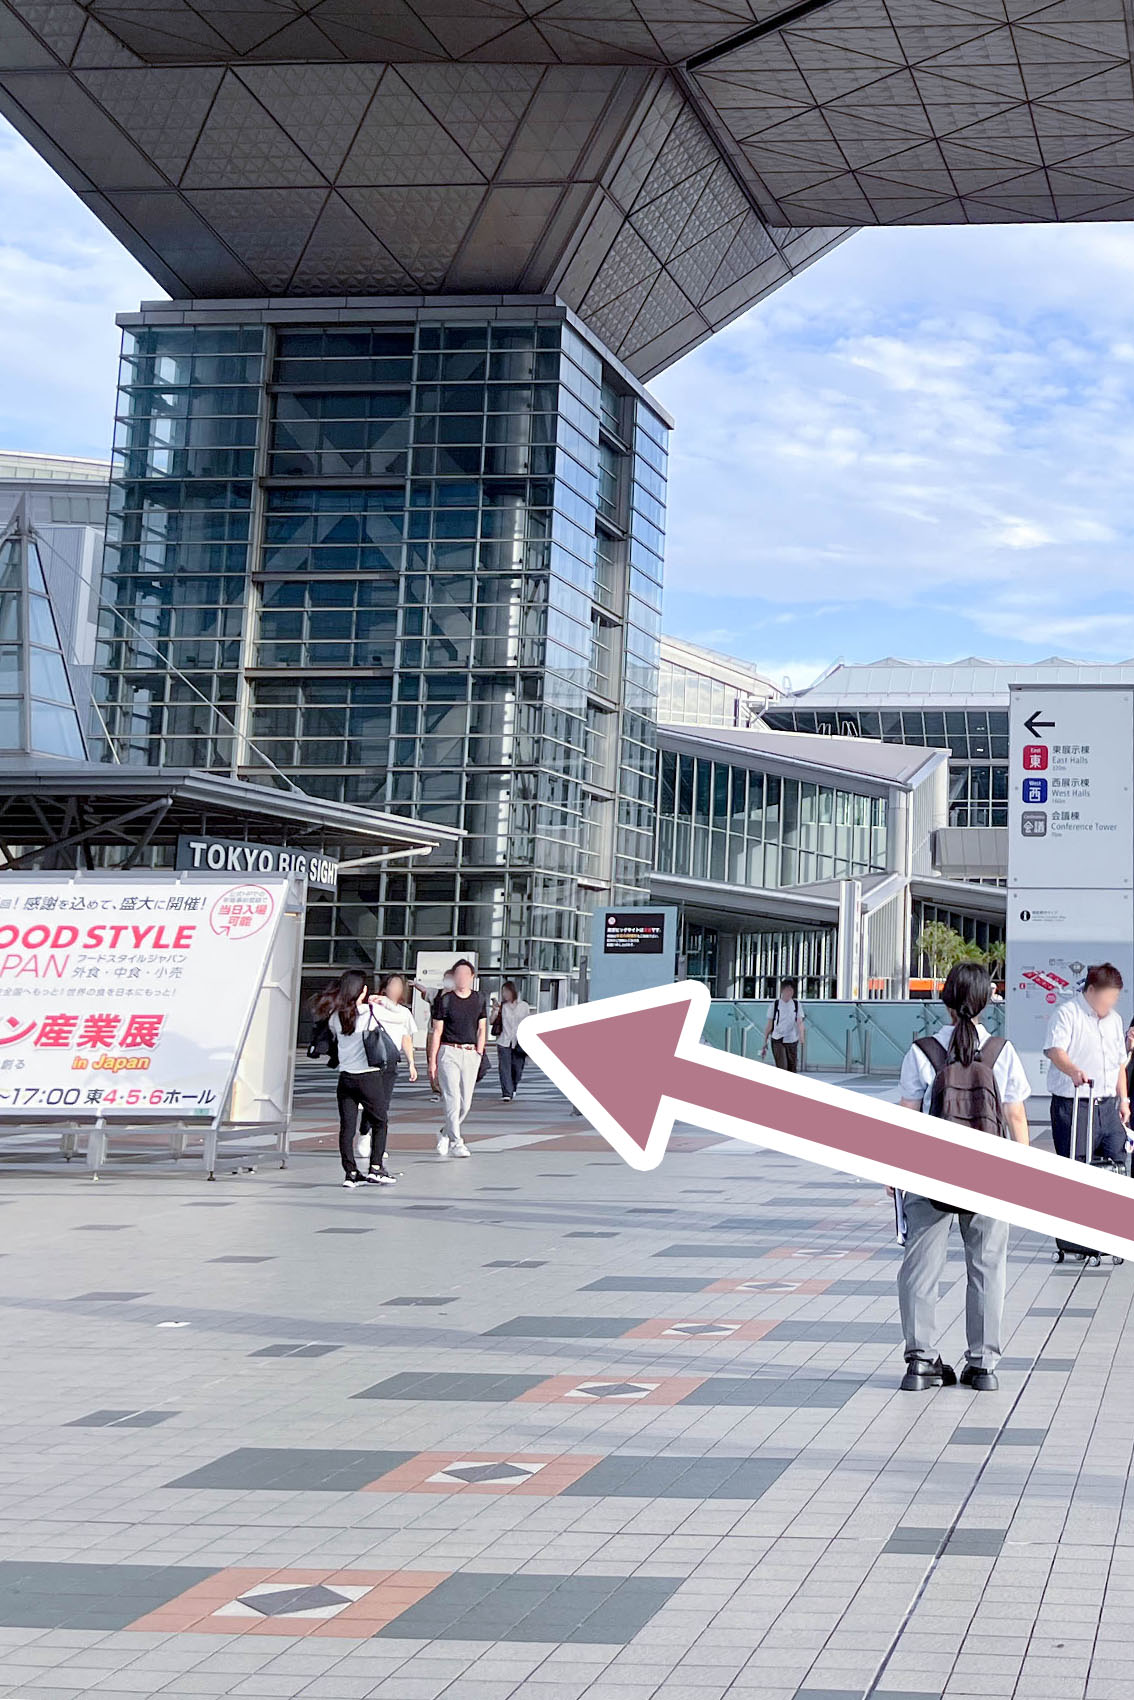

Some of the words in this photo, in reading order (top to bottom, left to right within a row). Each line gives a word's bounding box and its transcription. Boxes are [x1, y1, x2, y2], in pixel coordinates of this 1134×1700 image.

[1030, 754, 1041, 768] 東
[1052, 756, 1067, 764] East
[1070, 756, 1088, 764] Halls
[1029, 787, 1041, 801] 西
[1051, 789, 1070, 797] West
[1072, 789, 1090, 797] Halls
[1051, 822, 1093, 831] Conference
[1095, 823, 1117, 831] Tower
[189, 841, 274, 872] TOKYO
[279, 852, 307, 872] BIG
[309, 857, 339, 886] SIGHT
[82, 925, 197, 949] STYLE
[77, 953, 187, 964] フードスタイルジャパン
[72, 1056, 87, 1070] in
[92, 1054, 151, 1073] Japan
